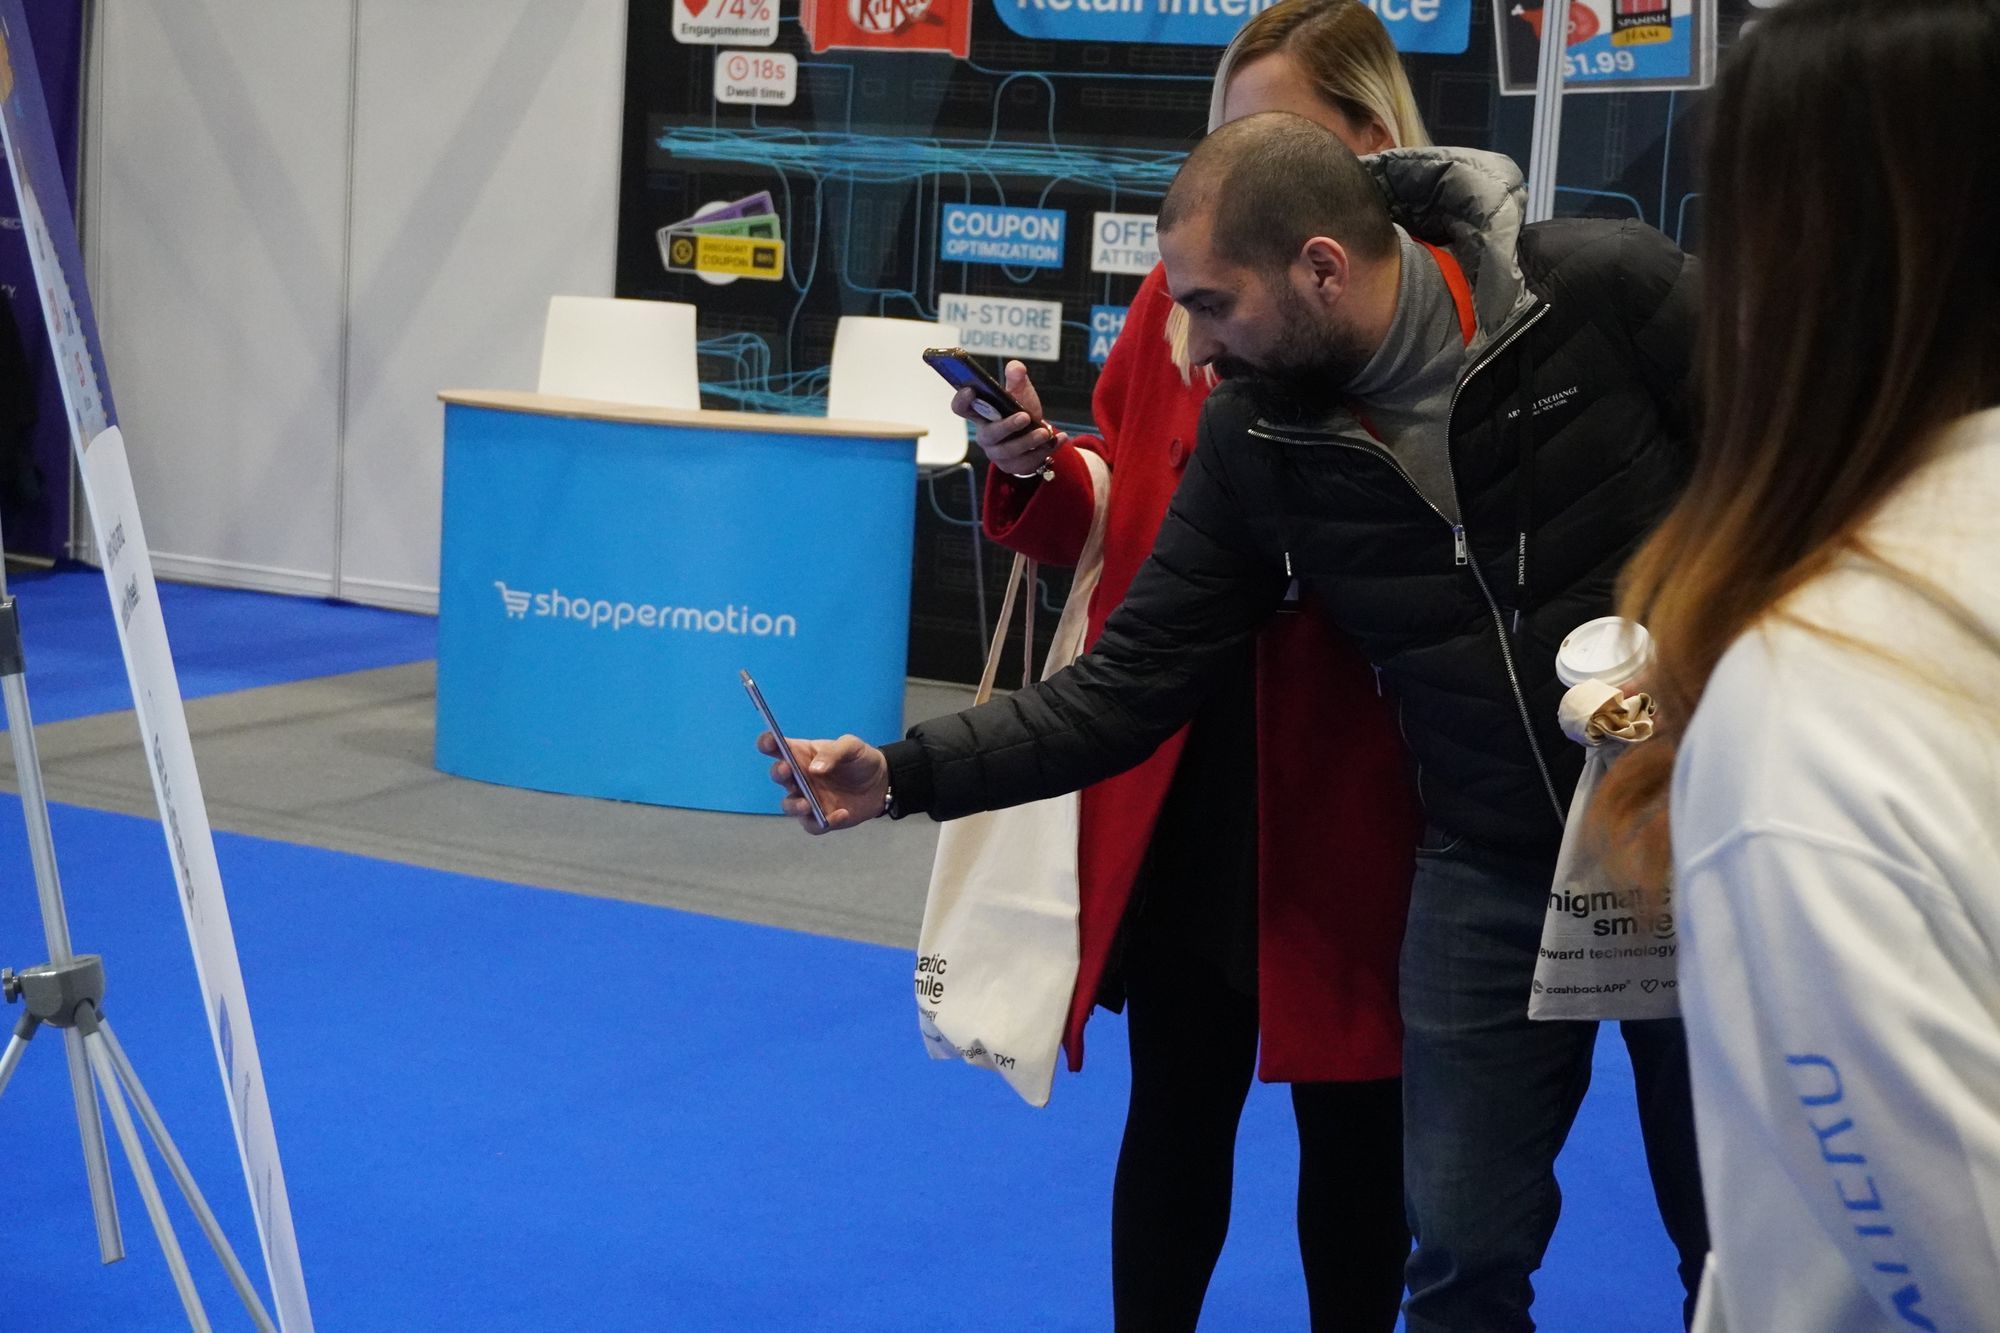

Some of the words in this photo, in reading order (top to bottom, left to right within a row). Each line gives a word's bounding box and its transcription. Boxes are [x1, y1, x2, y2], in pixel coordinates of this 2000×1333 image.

[753, 59, 786, 80] 18s
[1563, 50, 1635, 77] $1.99
[726, 85, 758, 97] Dwell
[761, 86, 786, 98] time
[947, 211, 1060, 241] COUPON
[946, 239, 1059, 262] OPTIMIZATION
[945, 302, 1052, 328] IN-STORE
[1538, 386, 1578, 407] EXCHANGE
[535, 588, 797, 638] shoppermotion
[1589, 943, 1677, 960] technology
